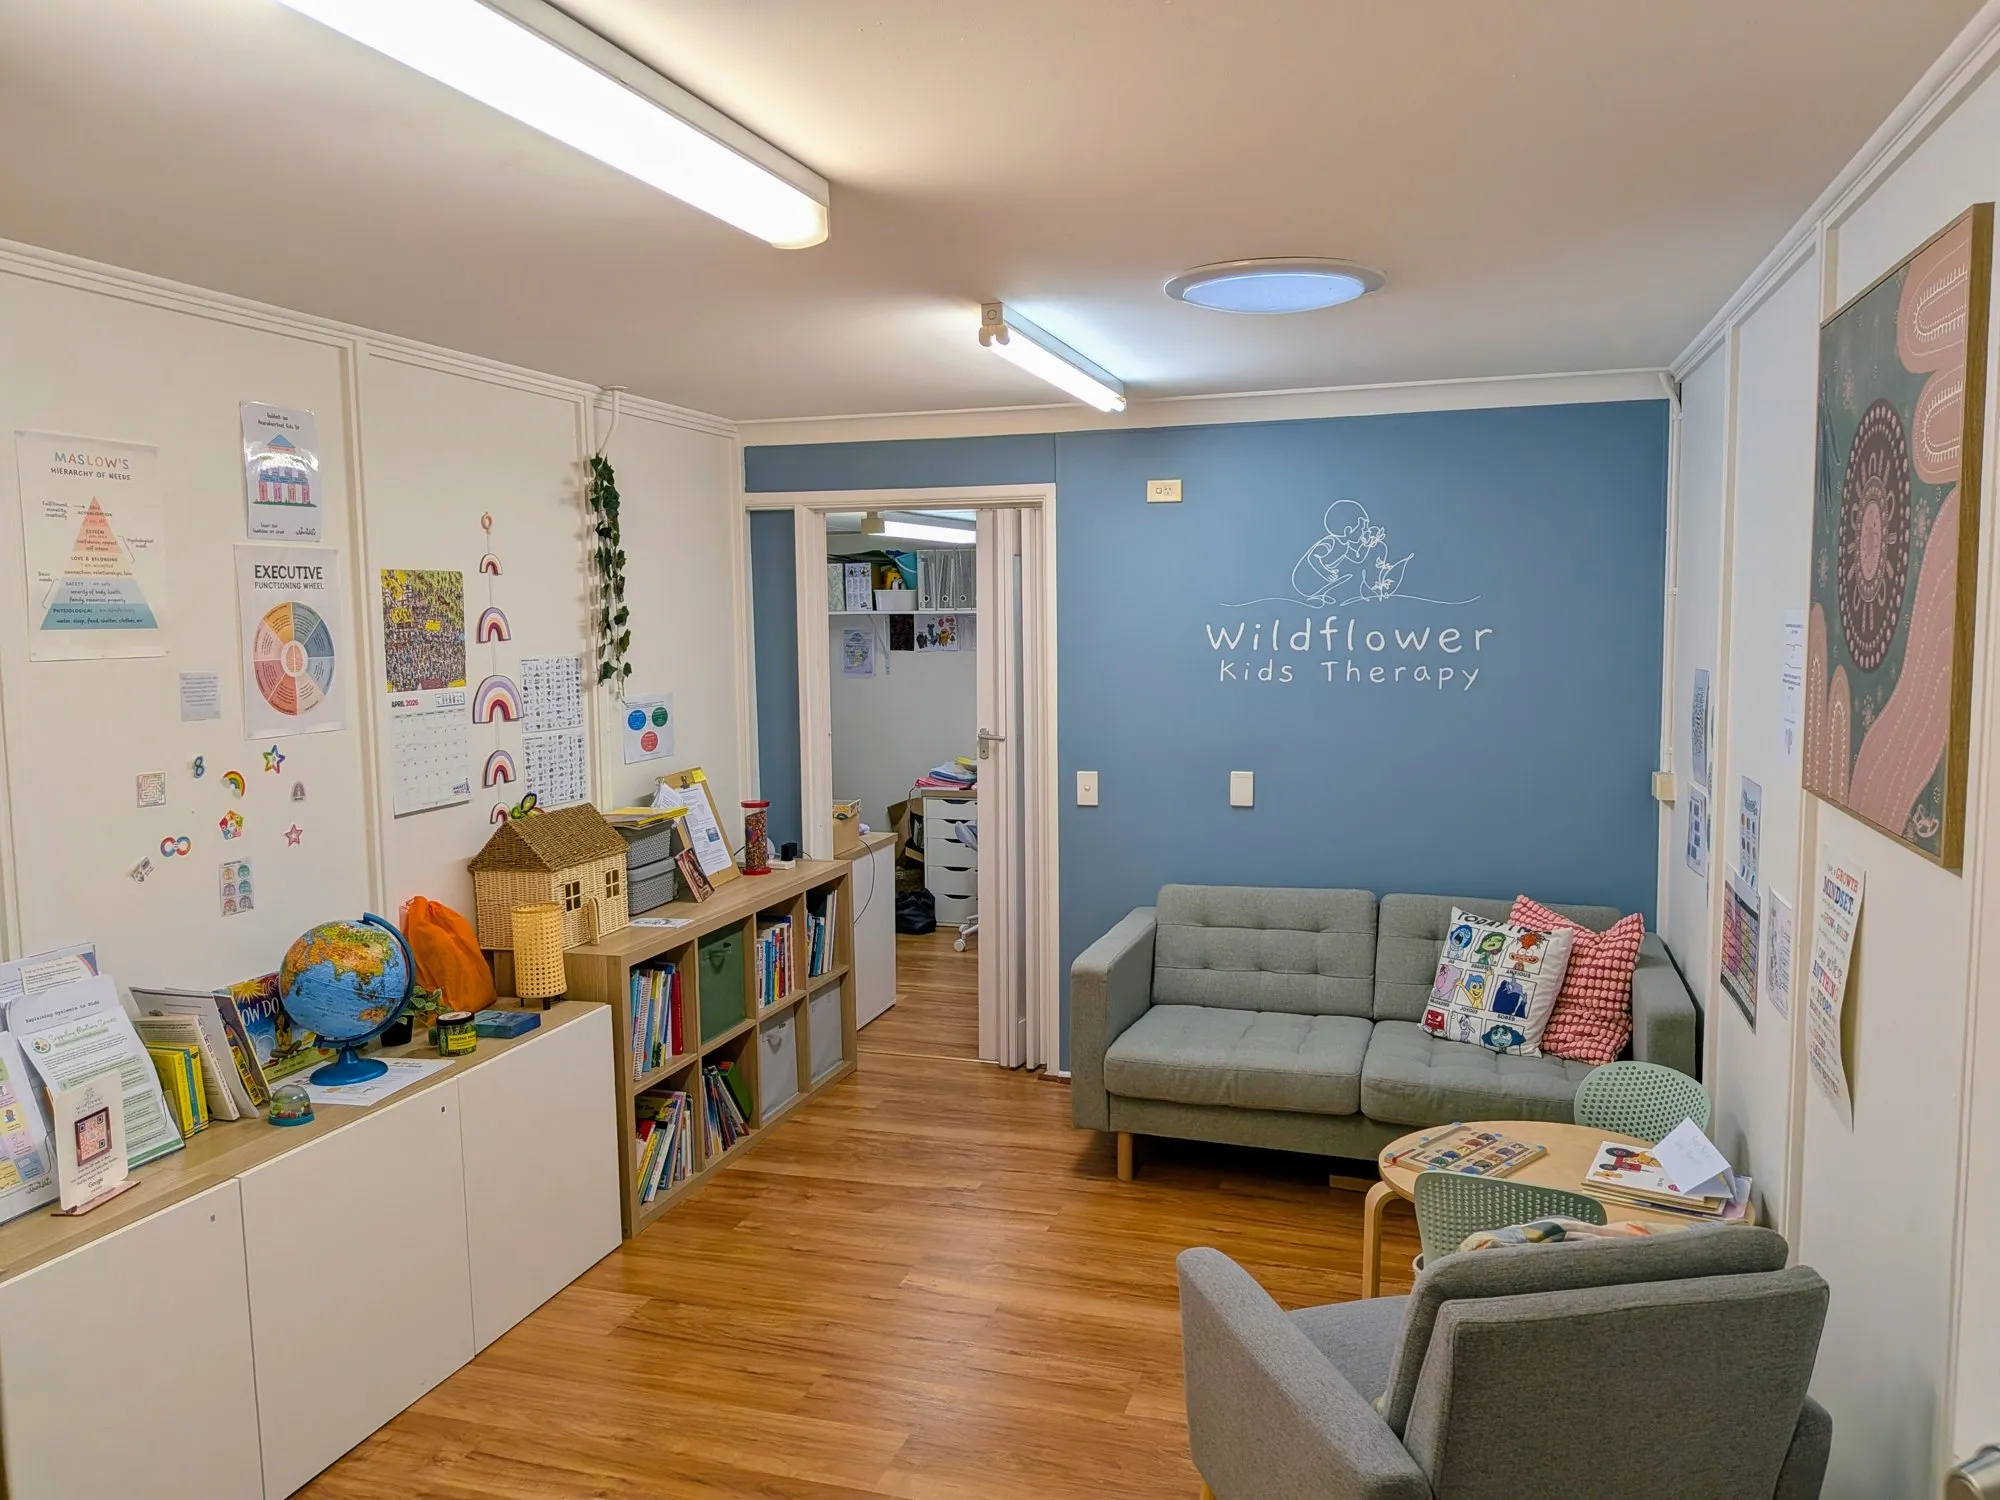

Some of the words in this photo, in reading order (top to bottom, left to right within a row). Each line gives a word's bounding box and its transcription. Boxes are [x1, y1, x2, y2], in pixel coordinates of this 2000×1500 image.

[54, 451, 130, 470] MASLOW'S
[50, 467, 94, 478] HIERARCHY
[96, 471, 106, 479] OF
[109, 473, 131, 481] NEEDS
[254, 564, 323, 580] EXECUTIVE
[254, 581, 302, 590] FUNCTIONING
[303, 581, 325, 590] WHEEL
[1206, 615, 1493, 653] Wildflower
[1219, 659, 1293, 683] Kids
[1320, 659, 1479, 691] Therapy
[391, 700, 405, 708] APRIL
[405, 699, 419, 707] 2026
[241, 1003, 260, 1027] OW
[261, 996, 280, 1018] DO
